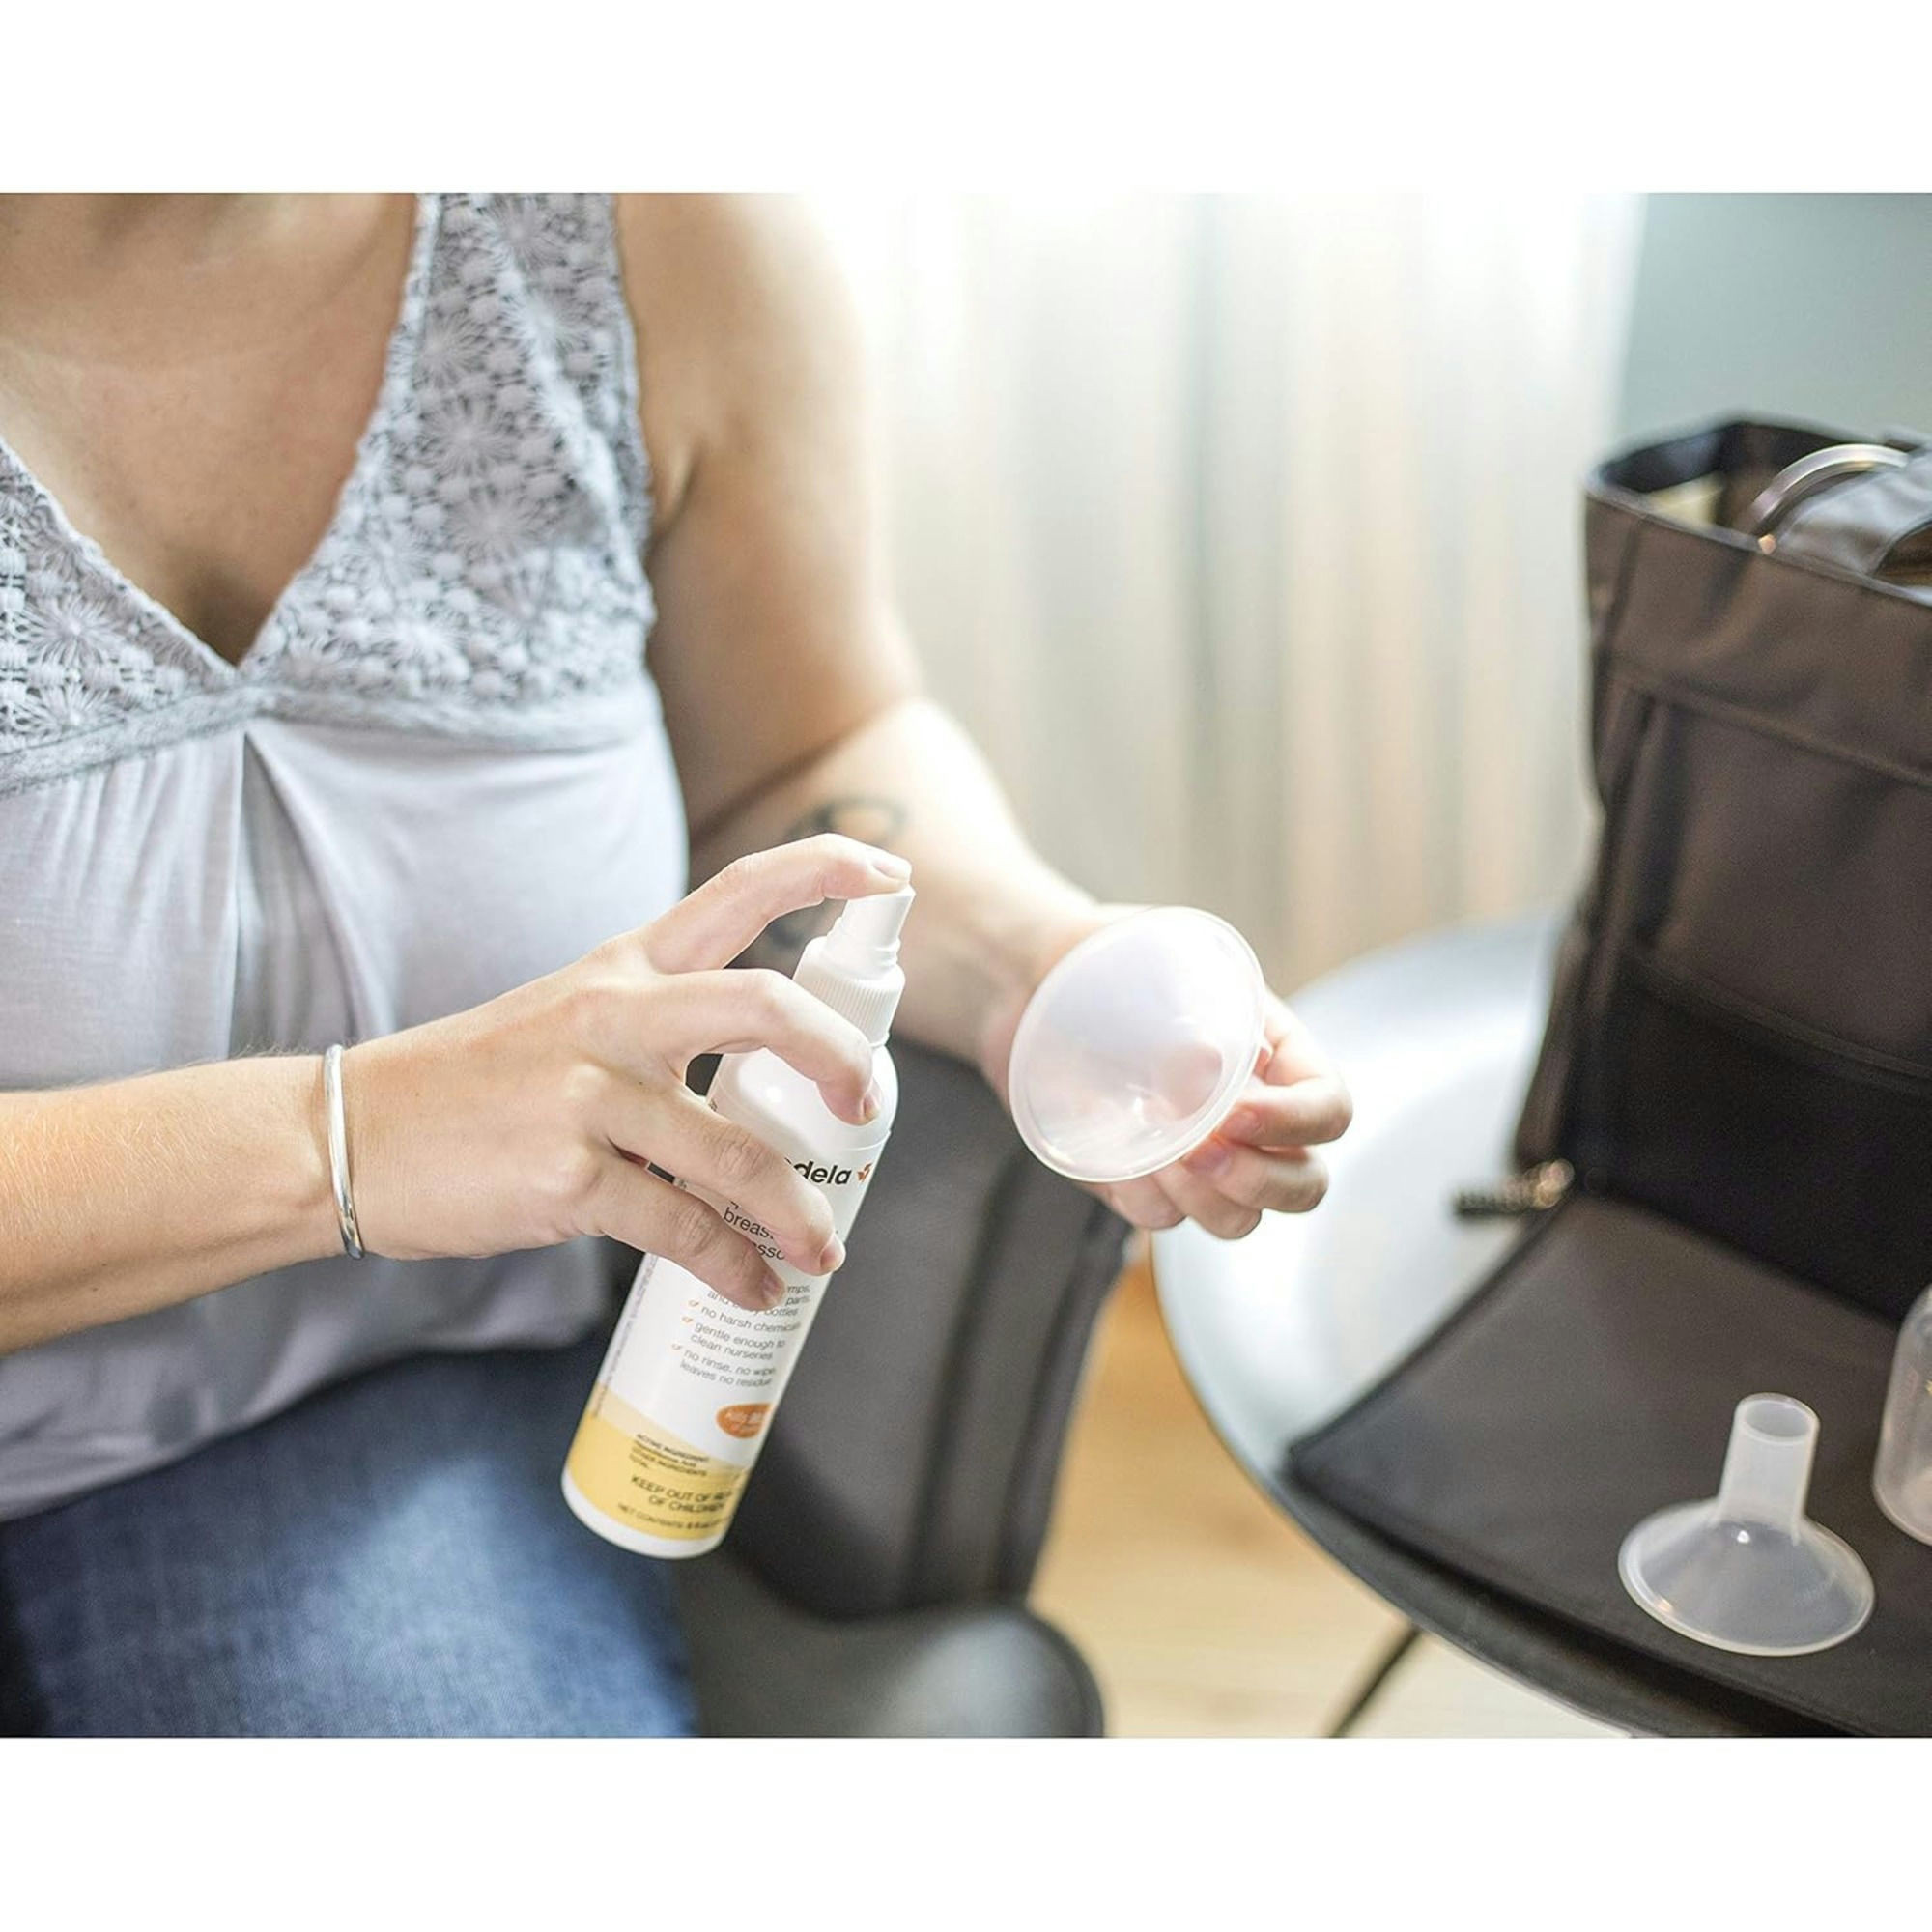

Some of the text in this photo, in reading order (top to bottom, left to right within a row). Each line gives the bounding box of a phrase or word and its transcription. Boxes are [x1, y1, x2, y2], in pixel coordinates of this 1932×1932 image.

[785, 1157, 852, 1185] dela
[723, 1207, 774, 1239] breas
[701, 1306, 716, 1319] no
[719, 1312, 752, 1329] harsh
[690, 1333, 722, 1350] clean
[695, 1321, 730, 1342] gentle
[733, 1335, 774, 1351] enough
[680, 1359, 716, 1381] leaves
[719, 1374, 734, 1386] no
[684, 1349, 699, 1362] no
[735, 1365, 751, 1376] no
[631, 1475, 664, 1493] KEEP
[667, 1488, 695, 1502] OUT
[696, 1492, 712, 1502] OF
[649, 1494, 668, 1506] OF
